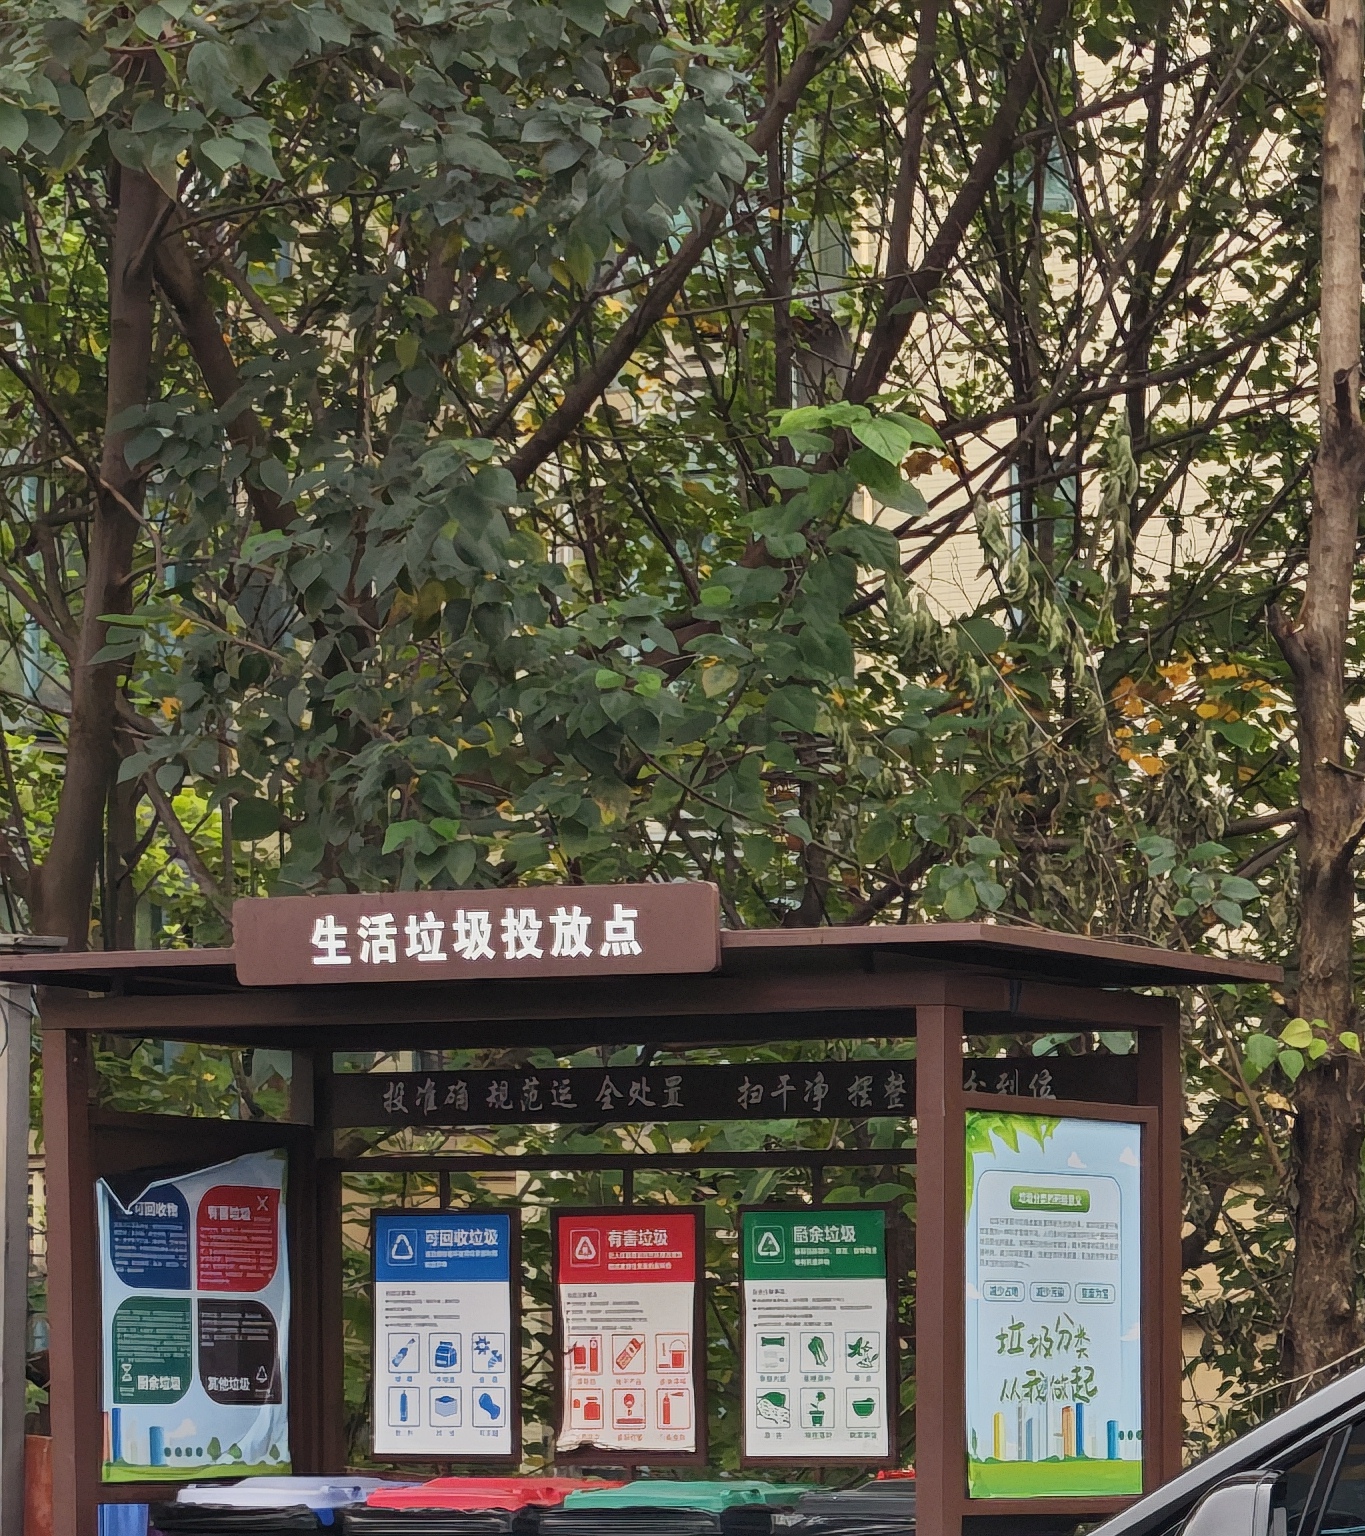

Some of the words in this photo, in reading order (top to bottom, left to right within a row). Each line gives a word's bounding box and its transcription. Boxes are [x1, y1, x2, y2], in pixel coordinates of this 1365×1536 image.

[309, 903, 643, 966] 生活垃圾投放点
[424, 1227, 499, 1247] 可回收垃圾
[607, 1228, 669, 1248] 有害垃圾
[995, 1312, 1091, 1359] 垃圾分类
[1000, 1365, 1098, 1404] 从我做起
